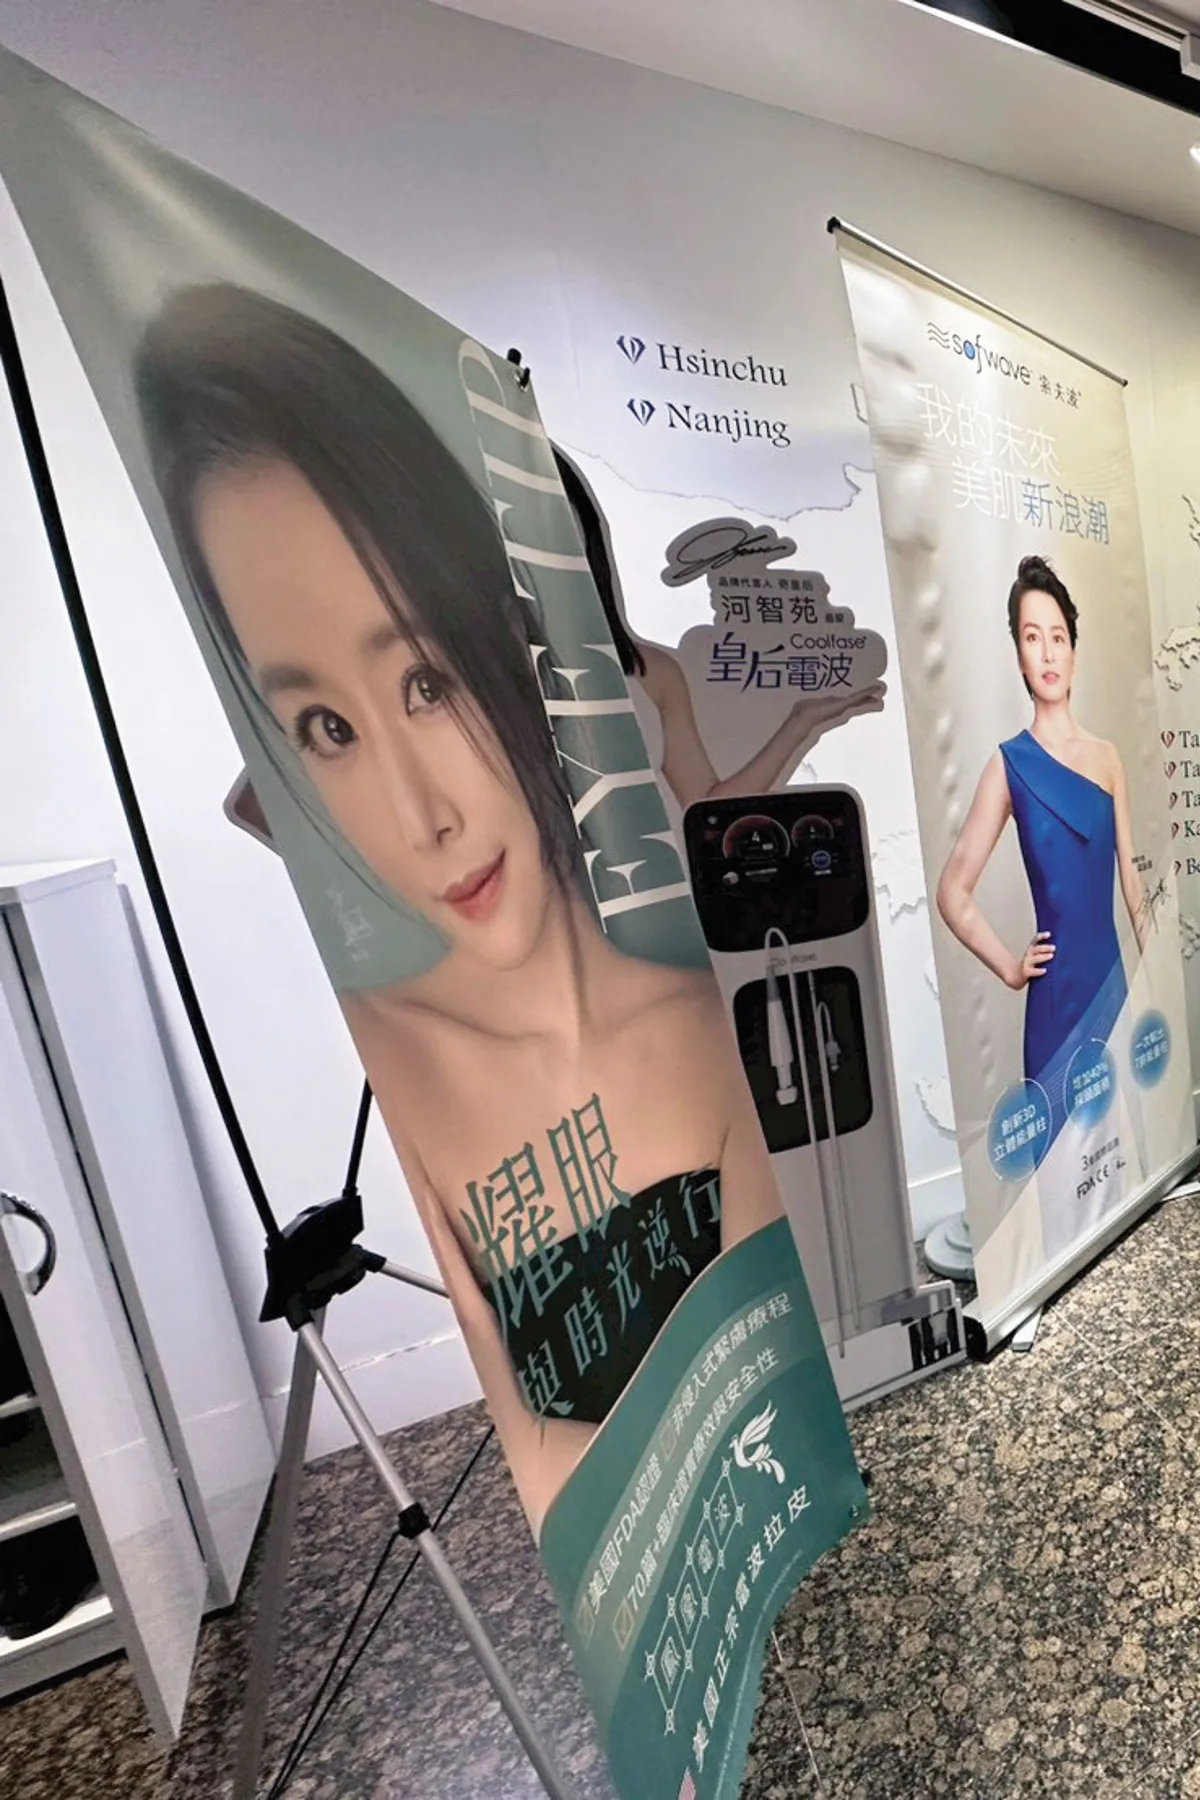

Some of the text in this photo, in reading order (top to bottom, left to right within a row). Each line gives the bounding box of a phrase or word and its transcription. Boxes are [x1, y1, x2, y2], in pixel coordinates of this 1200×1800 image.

[657, 342, 788, 386] Hsinchu
[952, 333, 1032, 386] sofwave
[666, 401, 791, 448] Nanjing
[916, 382, 1062, 478] 我的未來
[951, 454, 1110, 545] 美肌新浪潮
[721, 594, 818, 624] 河智苑
[706, 631, 853, 693] 皇后電波
[529, 641, 692, 935] EYE
[458, 1091, 632, 1340] 耀眼
[517, 1161, 721, 1448] 與時光逆行
